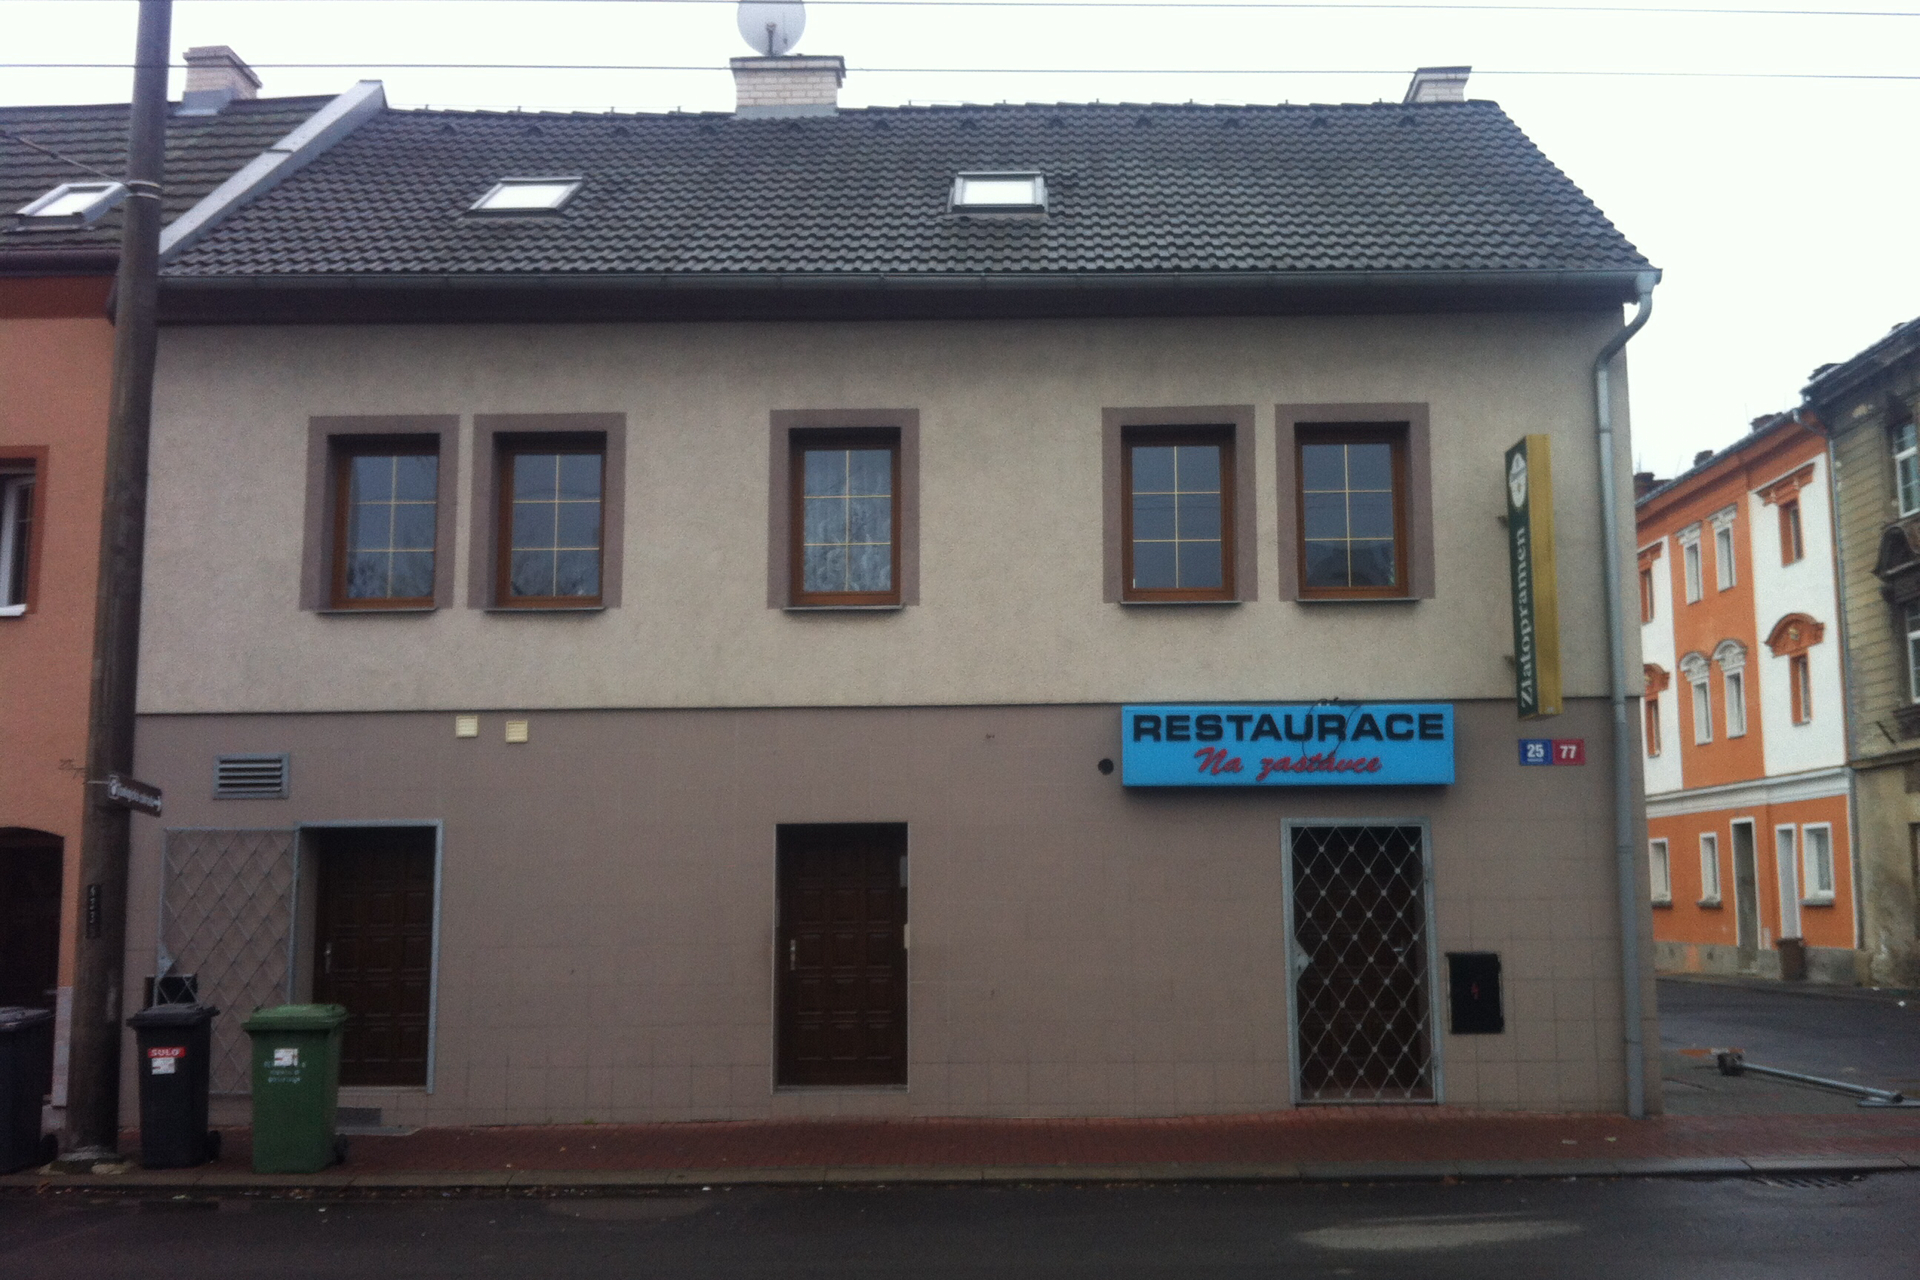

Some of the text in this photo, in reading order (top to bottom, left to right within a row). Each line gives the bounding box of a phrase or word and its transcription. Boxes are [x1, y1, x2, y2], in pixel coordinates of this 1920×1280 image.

[1517, 527, 1535, 708] Zlatopramen
[1133, 713, 1445, 742] RESTAURACE
[1194, 746, 1244, 775] Na
[1526, 743, 1545, 758] 25
[1559, 744, 1577, 759] 77
[151, 1048, 180, 1057] SULO
